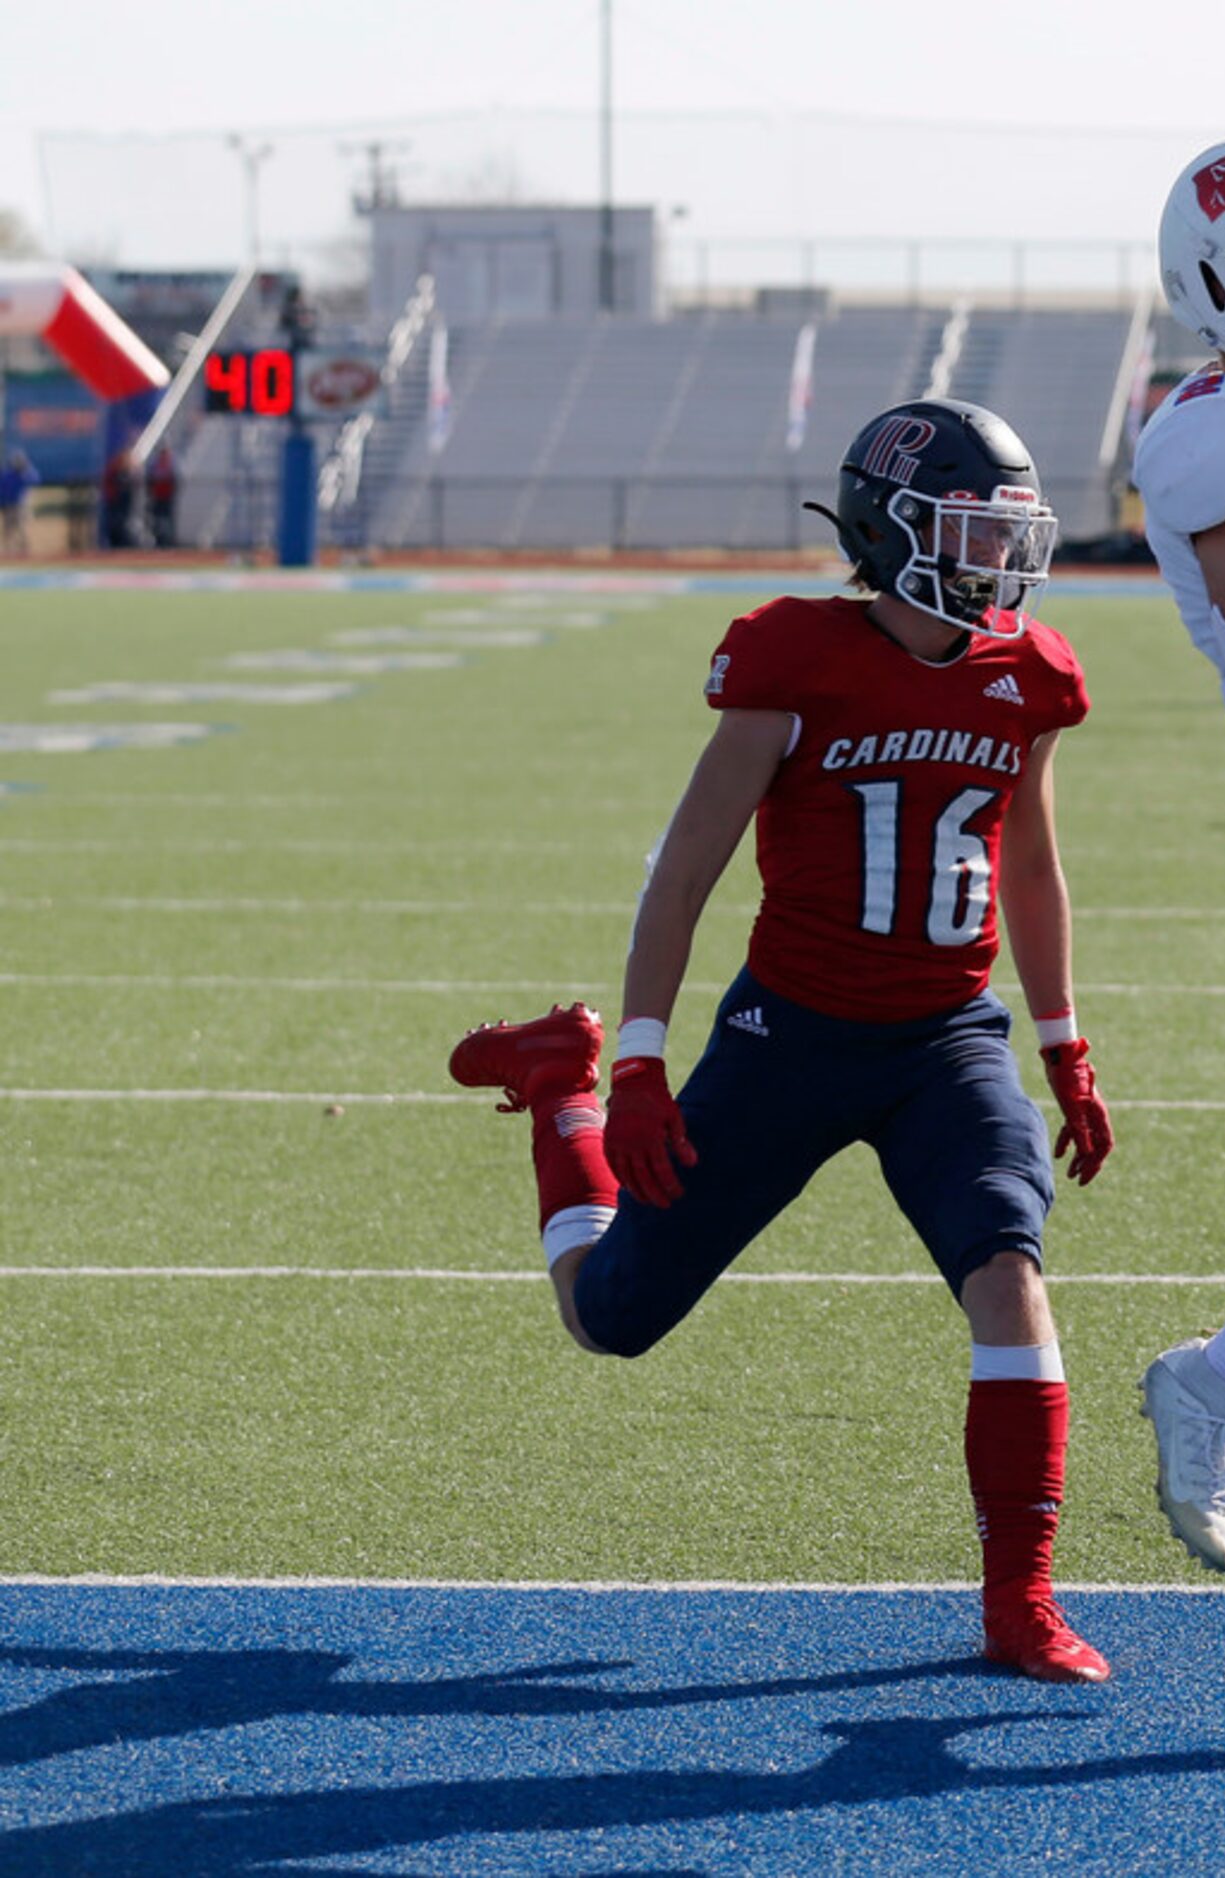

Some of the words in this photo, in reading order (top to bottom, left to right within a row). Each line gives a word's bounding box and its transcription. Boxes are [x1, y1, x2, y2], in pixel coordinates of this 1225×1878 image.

[204, 349, 293, 416] 40
[822, 728, 1021, 776] CARDINALS
[850, 778, 999, 948] 16
